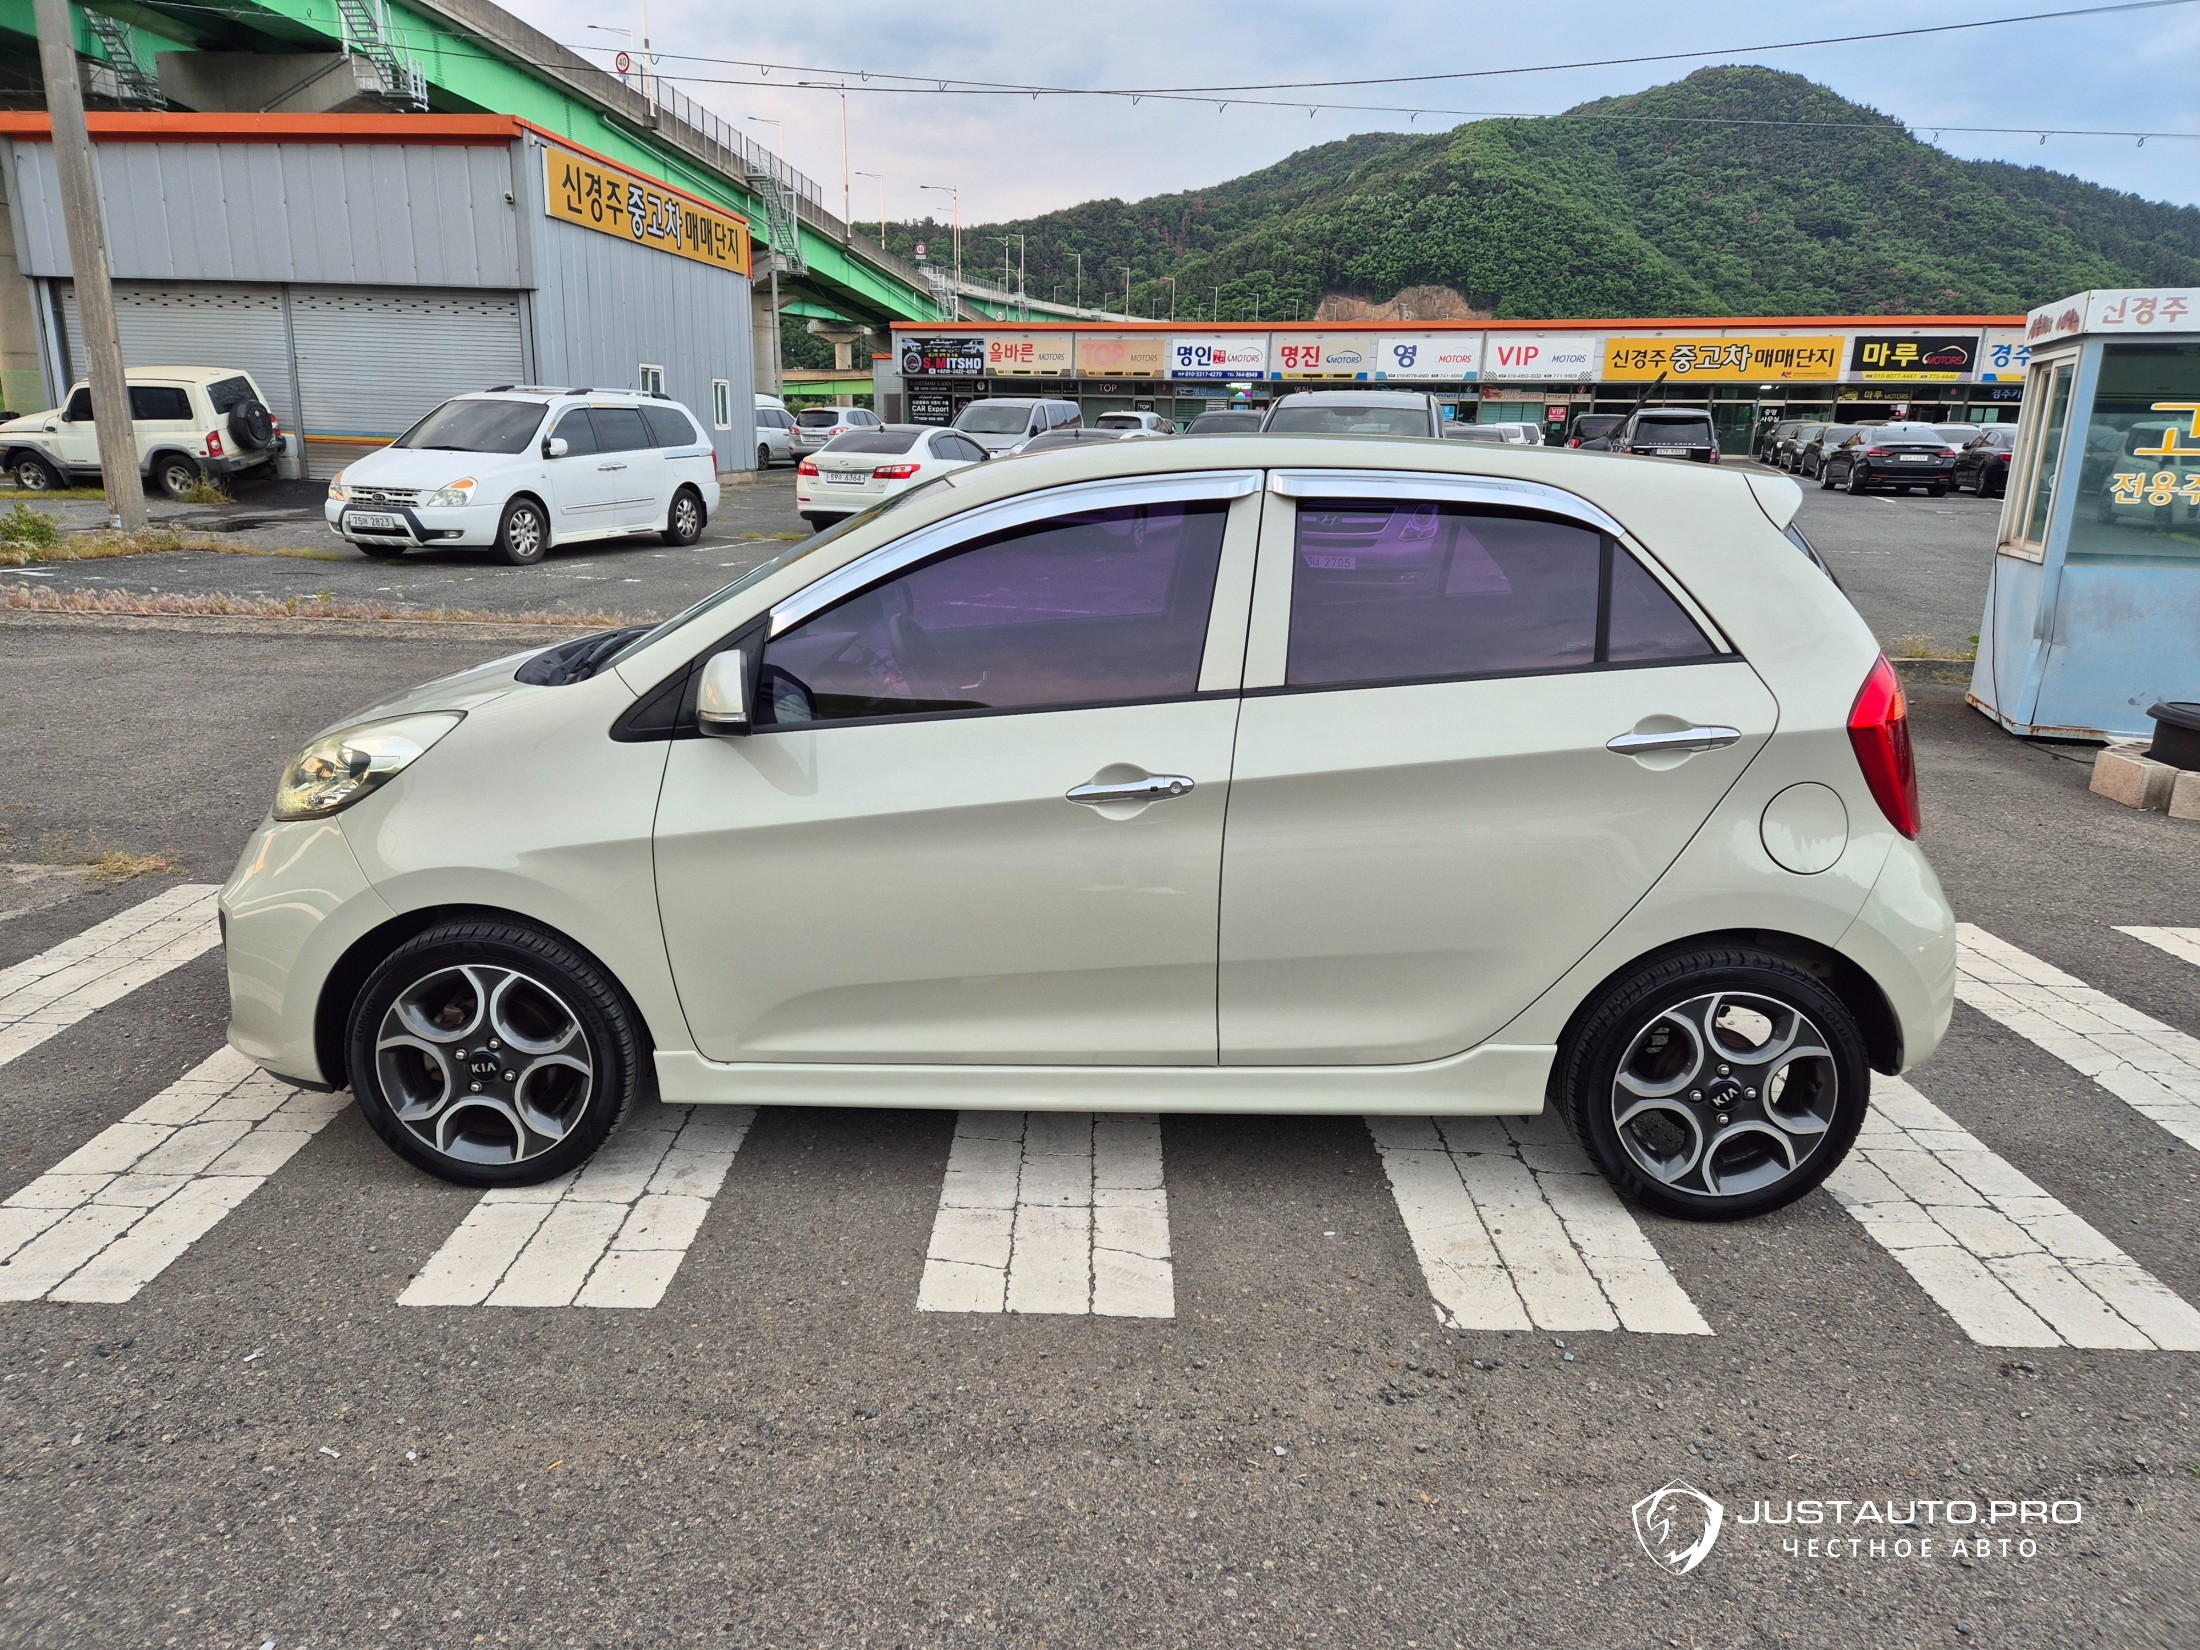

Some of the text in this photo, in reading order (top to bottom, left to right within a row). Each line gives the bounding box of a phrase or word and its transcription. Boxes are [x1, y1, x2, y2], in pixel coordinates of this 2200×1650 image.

[618, 58, 626, 66] 40
[562, 164, 739, 264] 신경주 중고차 매매단지
[2102, 296, 2189, 325] 신경주
[989, 342, 1034, 363] 올바른
[1038, 353, 1065, 361] MOTORS
[1082, 343, 1125, 366] TOP
[1130, 354, 1158, 362] MOTORS
[1177, 346, 1212, 366] 명인
[1231, 354, 1260, 362] MOTORS
[1281, 346, 1320, 368] 명진
[1393, 344, 1418, 368] 영
[1498, 346, 1540, 366] VIP
[1862, 342, 1920, 367] 마루
[1991, 344, 2032, 368] 경주
[1330, 356, 1360, 364] MOTORS
[1438, 354, 1472, 363] MOTORS
[1552, 354, 1587, 363] MOTORS
[1612, 344, 1835, 373] 신경주 중고차 매매단지
[1926, 356, 1964, 364] MOTORS
[1098, 384, 1117, 392] TOP
[1504, 390, 1520, 398] VIP
[1864, 390, 1882, 400] 마루
[844, 474, 861, 482] 6364
[370, 518, 390, 526] 2823
[1324, 557, 1350, 568] 2705
[471, 1062, 497, 1073] KIA
[1712, 1088, 1738, 1106] KIA
